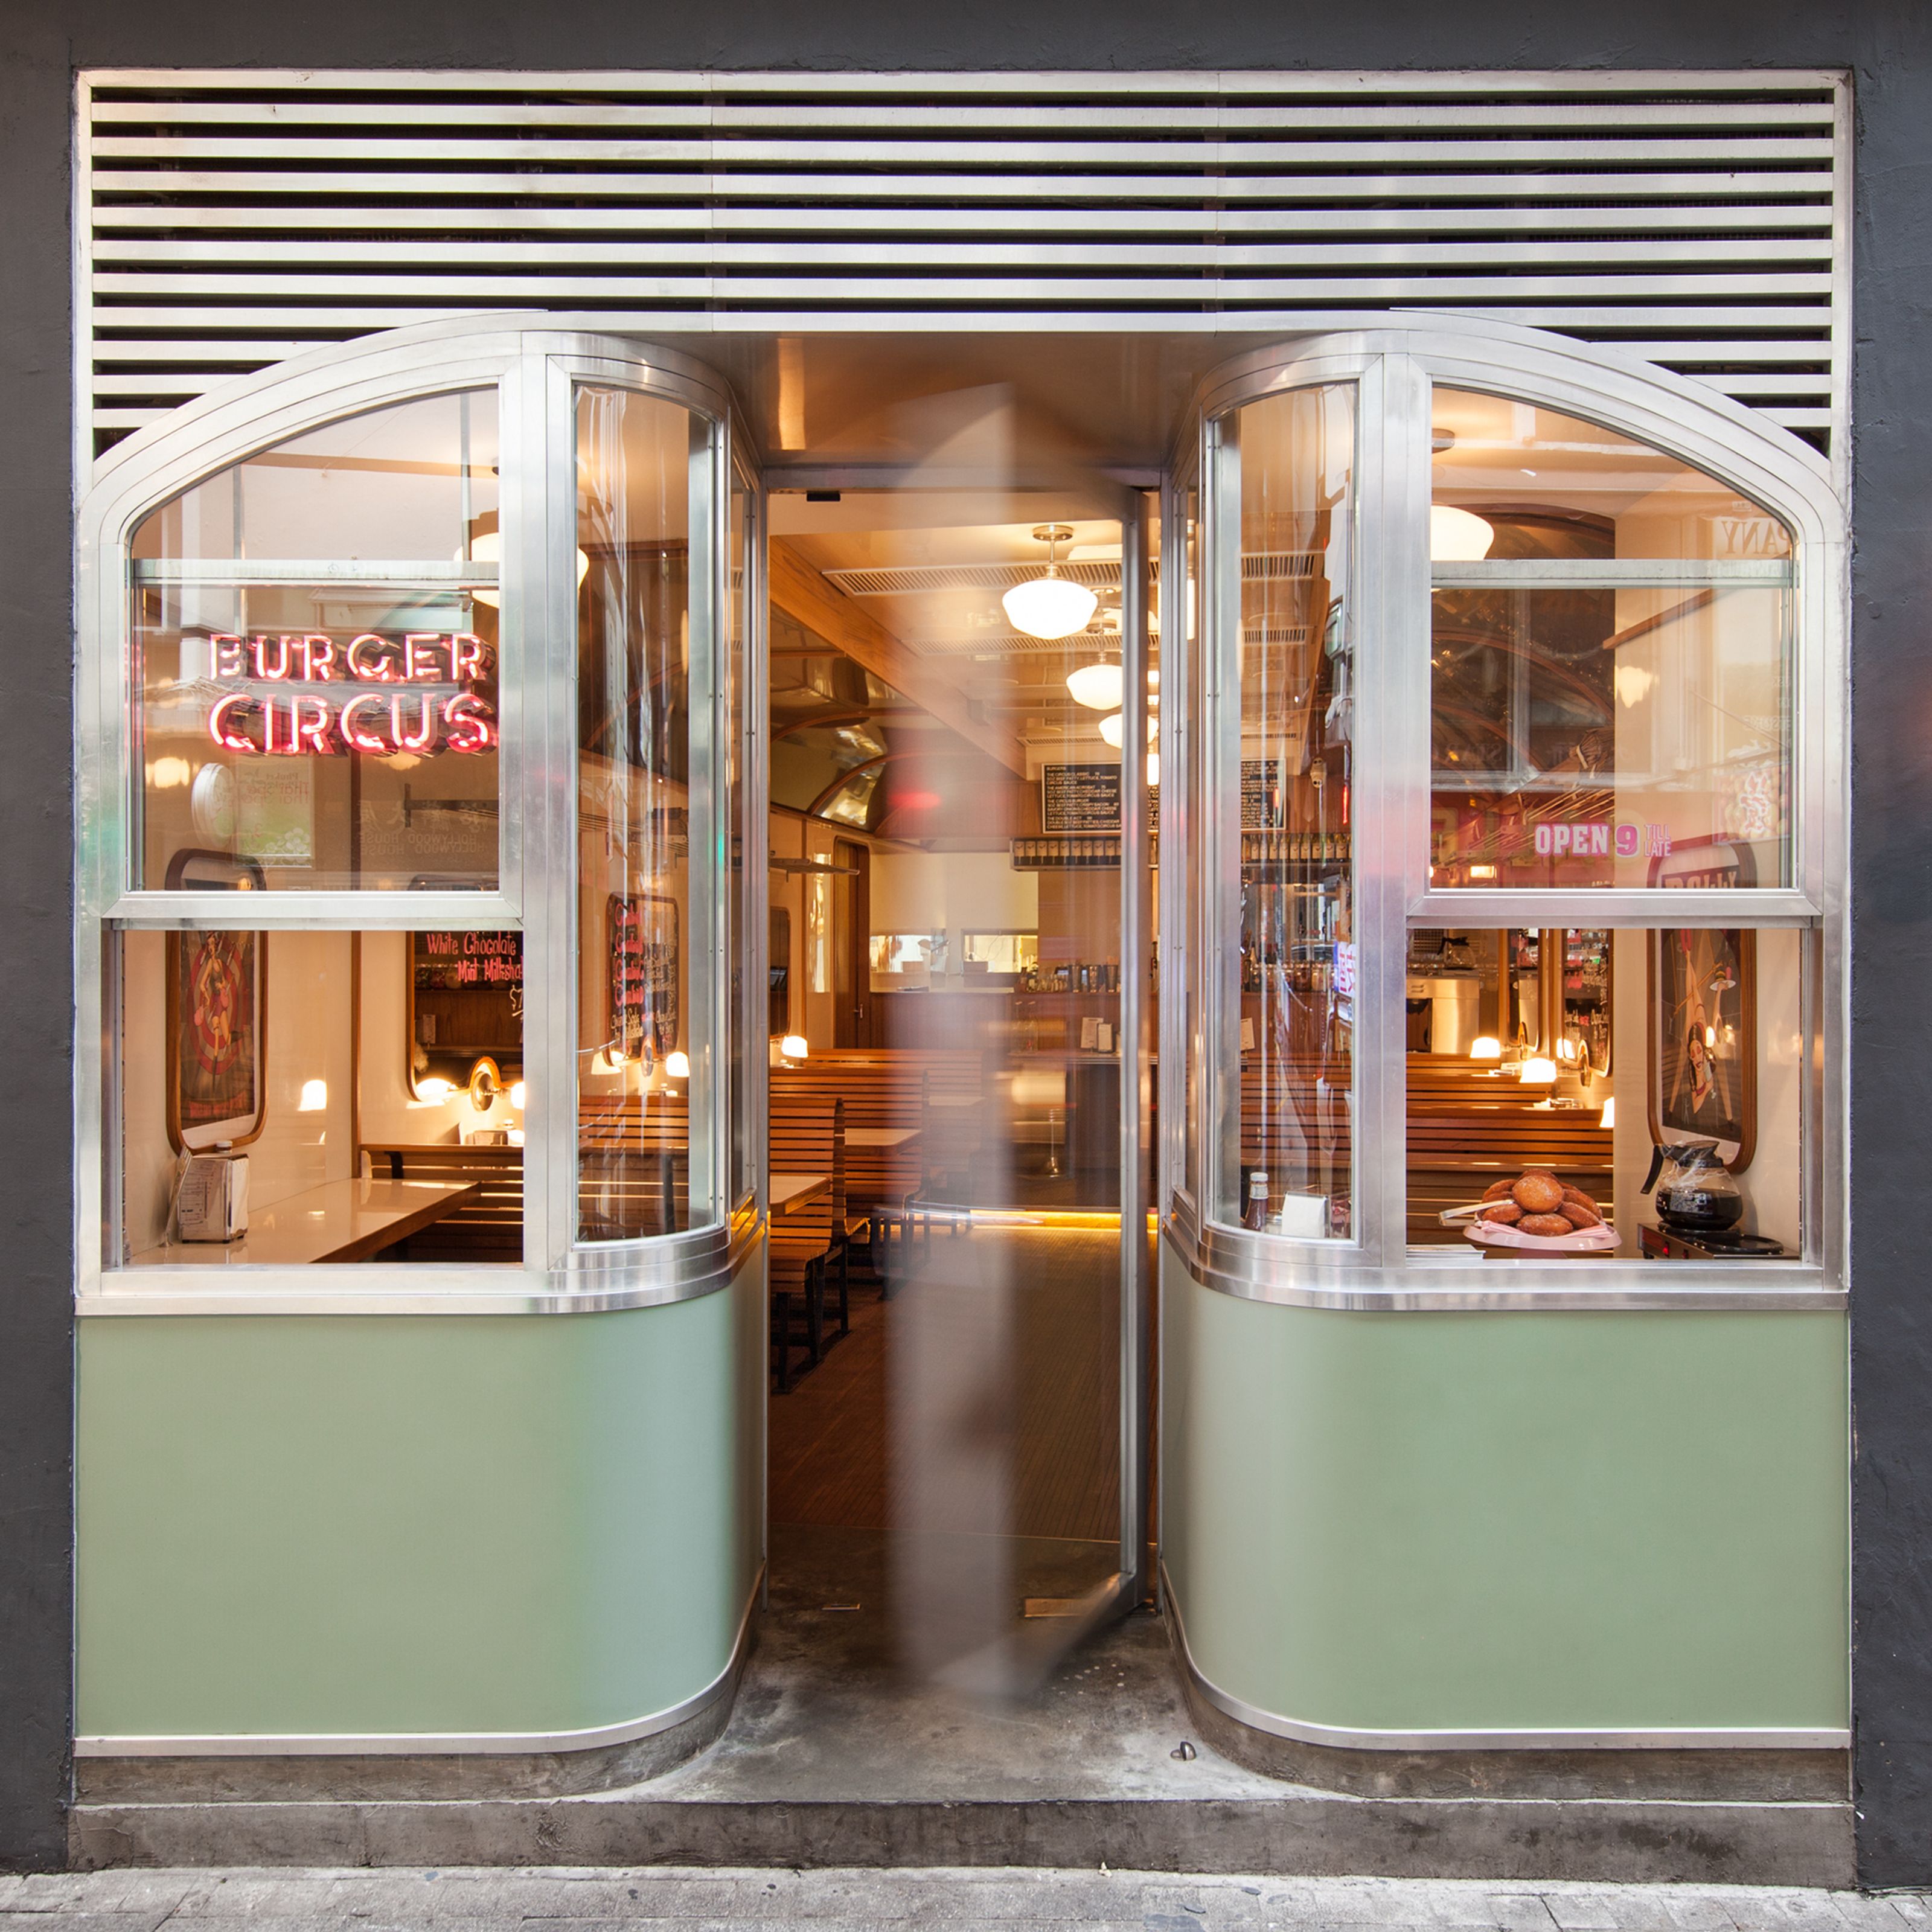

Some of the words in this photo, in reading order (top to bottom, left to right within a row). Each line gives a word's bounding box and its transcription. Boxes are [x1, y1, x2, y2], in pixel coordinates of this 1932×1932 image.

[210, 633, 487, 682] BURGER
[210, 693, 492, 754] CIRCUS
[1535, 824, 1610, 856] OPEN
[1615, 824, 1640, 858] 9
[1645, 824, 1671, 840] TILL
[1644, 841, 1671, 857] LATE
[426, 932, 459, 955] White
[464, 931, 517, 956] Chocolate
[457, 957, 479, 983] Mint
[484, 955, 524, 982] Milksha
